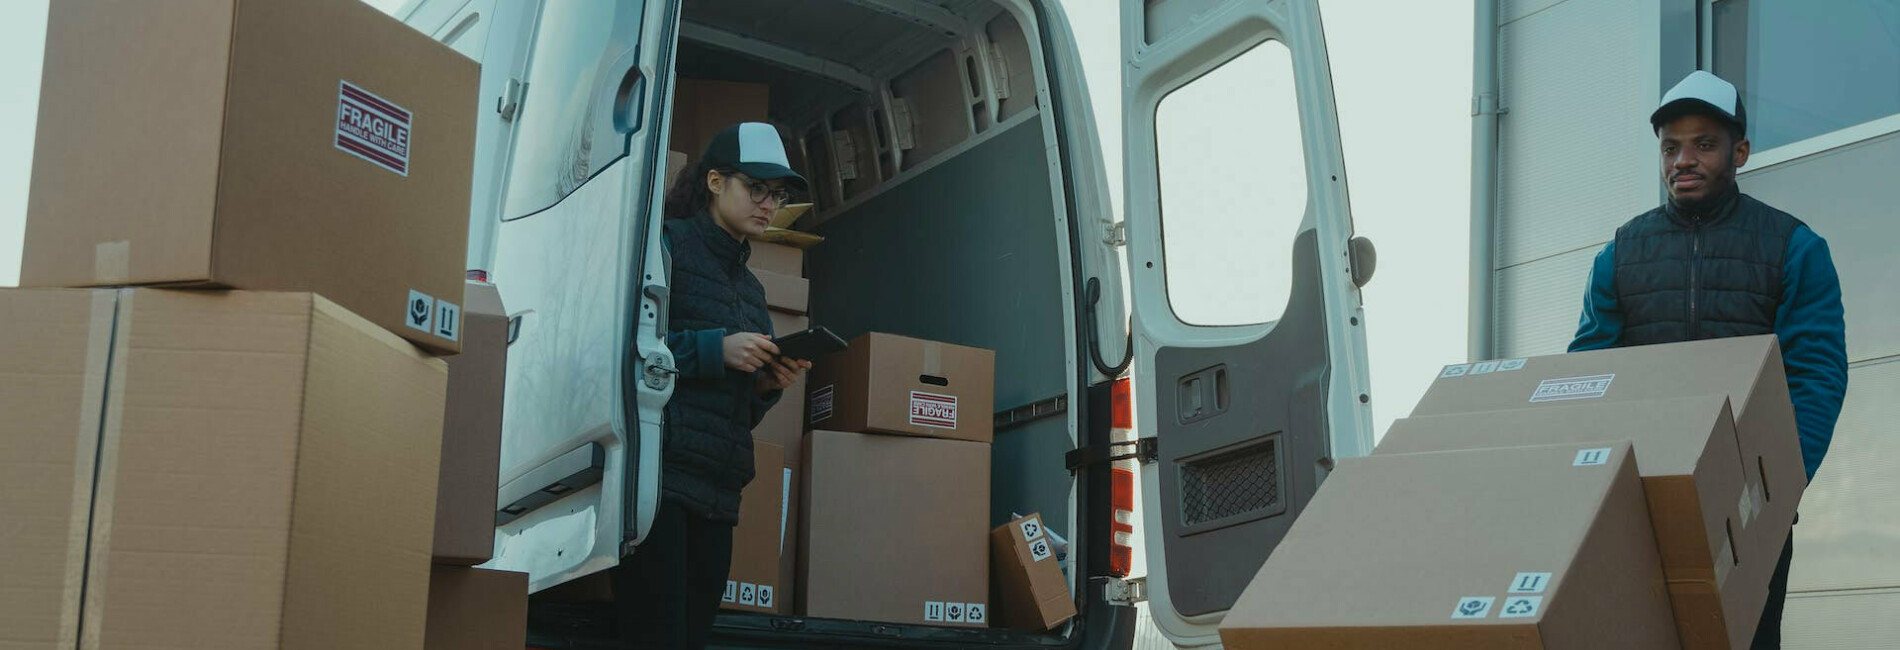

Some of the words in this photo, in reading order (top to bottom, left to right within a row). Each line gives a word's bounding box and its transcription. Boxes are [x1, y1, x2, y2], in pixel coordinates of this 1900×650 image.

[341, 102, 407, 147] FRAGILE
[340, 121, 369, 139] HANDLE
[369, 133, 387, 148] WITH
[387, 141, 406, 156] CARE
[1539, 381, 1607, 394] FRAGILE
[912, 405, 955, 419] FRAGILE
